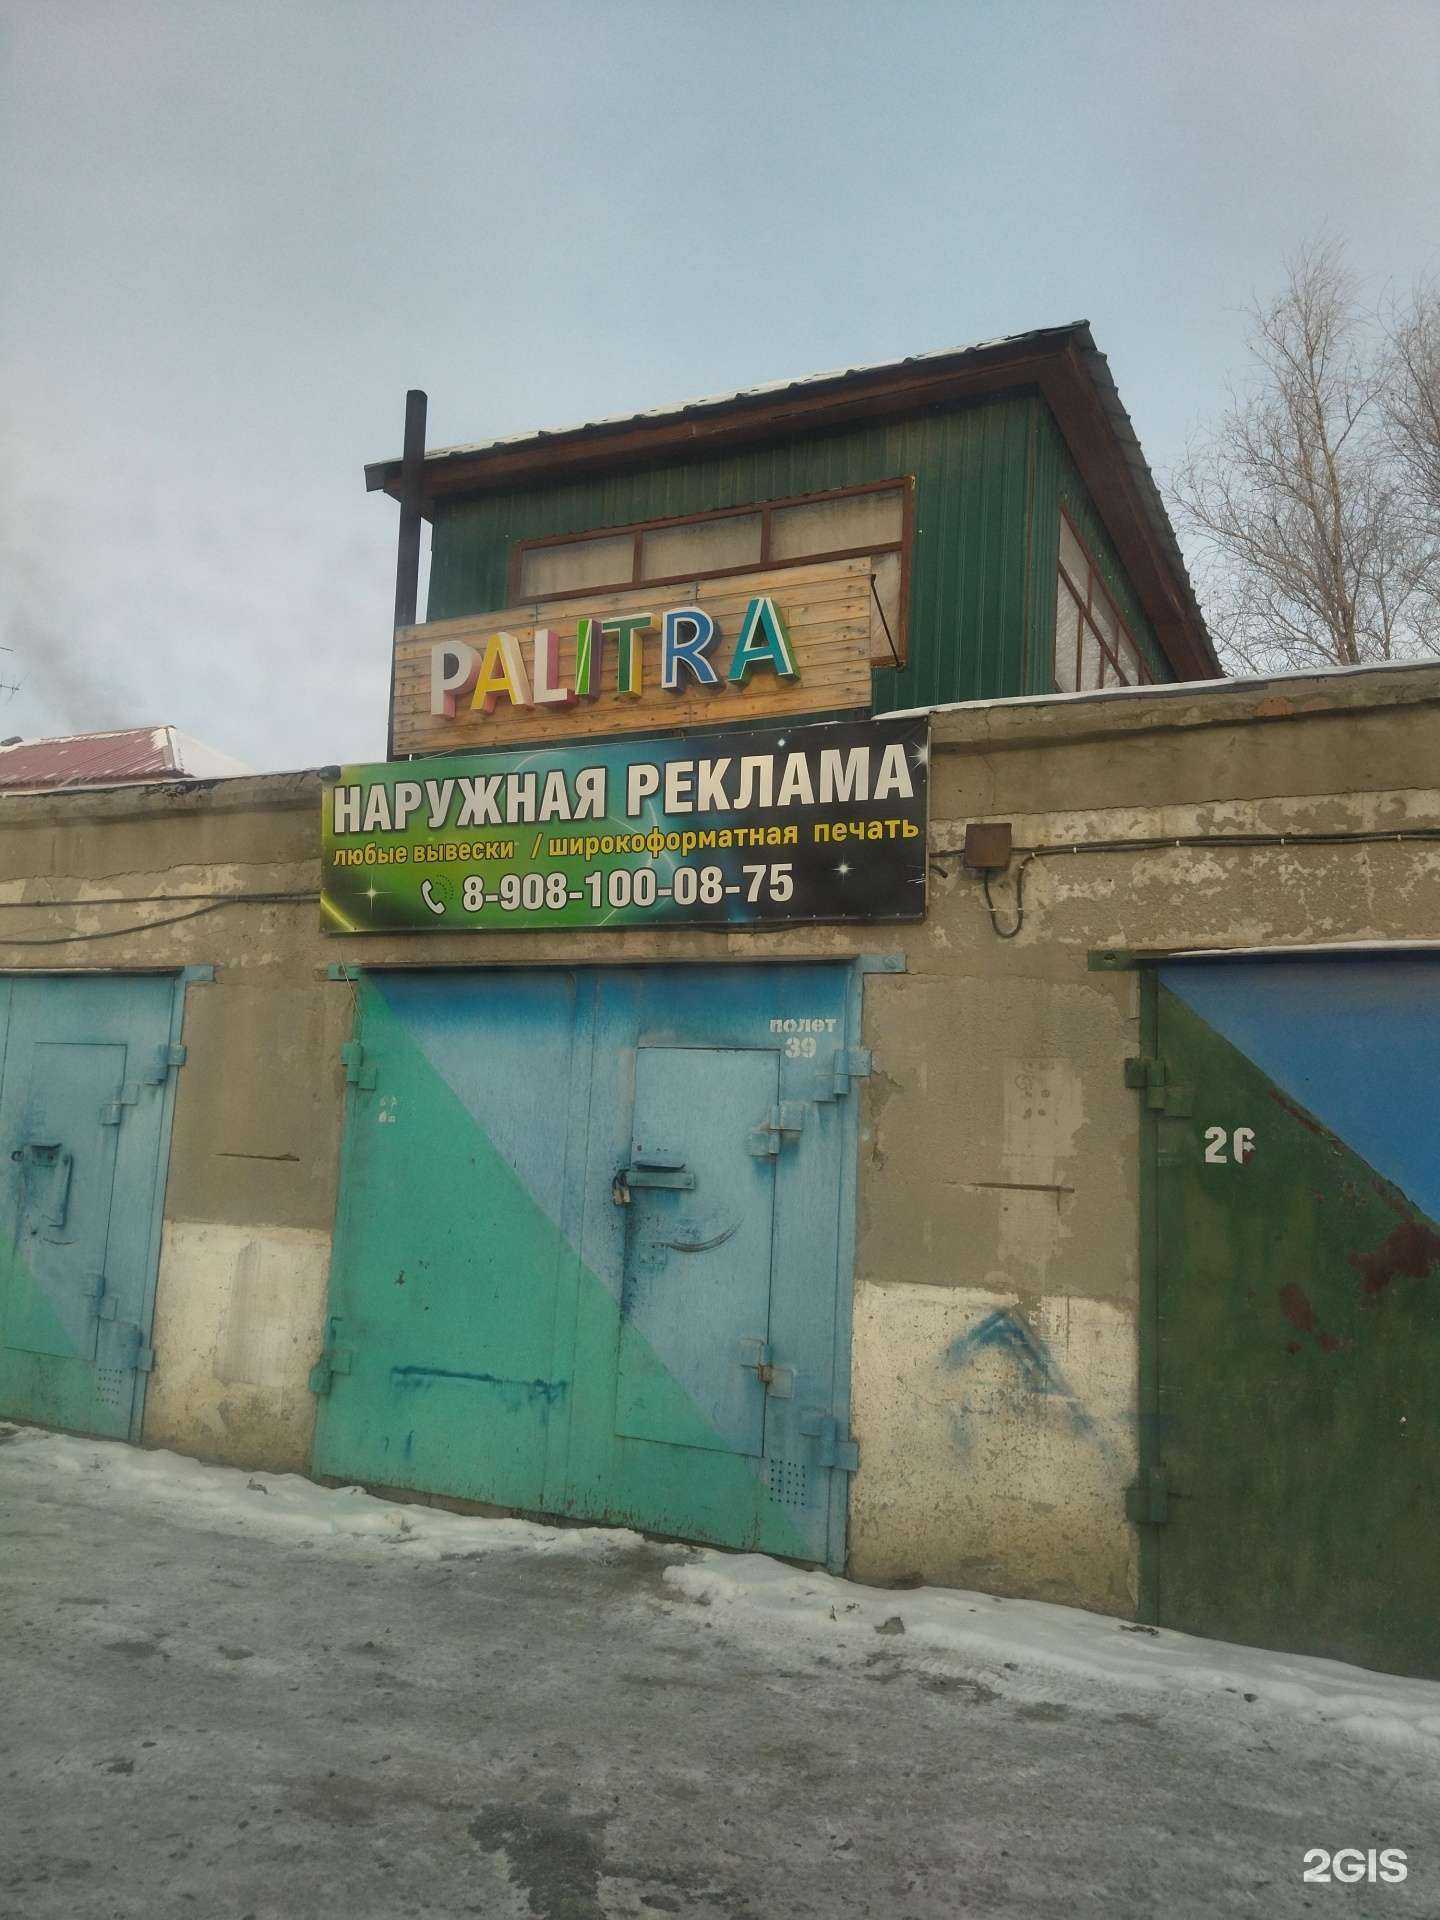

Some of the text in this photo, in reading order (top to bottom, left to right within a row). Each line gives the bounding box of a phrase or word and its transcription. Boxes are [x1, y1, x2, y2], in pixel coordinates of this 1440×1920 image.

[430, 596, 800, 719] PALITRA
[333, 743, 914, 835] НАРУЖНАЯ РЕКЛАМА
[332, 842, 408, 867] любые
[413, 840, 514, 864] вывески
[548, 824, 798, 860] широкоформатная
[813, 818, 920, 843] печать
[462, 862, 795, 913] 8-908-100-08-75
[784, 1037, 817, 1058] 39
